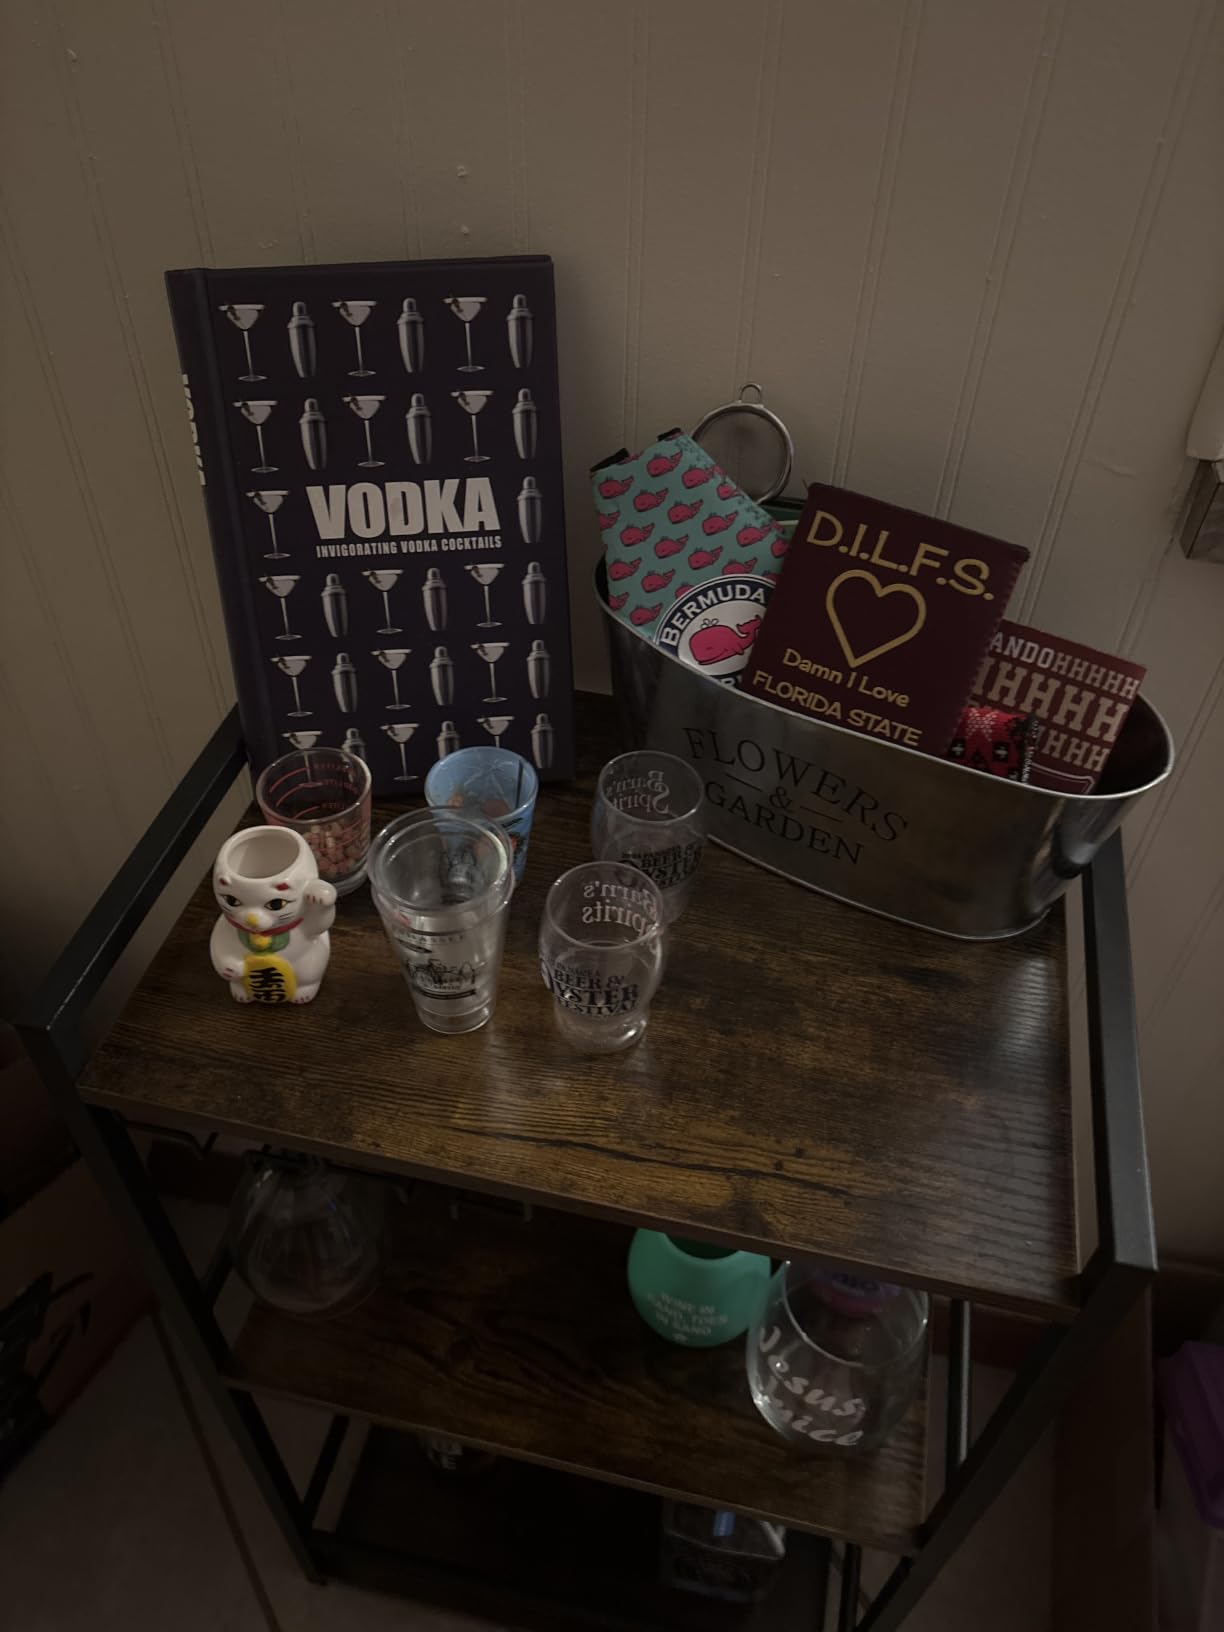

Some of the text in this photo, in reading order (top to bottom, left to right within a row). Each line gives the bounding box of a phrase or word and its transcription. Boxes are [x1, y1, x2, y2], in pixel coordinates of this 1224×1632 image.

[305, 477, 501, 540] VODKA
[316, 535, 502, 559] INVIGORATING VODKA COCKTAILS
[806, 510, 994, 601] D.I.L.F.S.
[660, 584, 767, 647] BERMUDA
[752, 669, 923, 747] FLORIDA STATE
[782, 648, 843, 685] Damn
[846, 671, 858, 689] I
[857, 676, 911, 709] Love
[682, 727, 909, 841] FLOWERS
[768, 786, 793, 809] &
[704, 781, 864, 864] GARDEN
[555, 968, 602, 990] BEER
